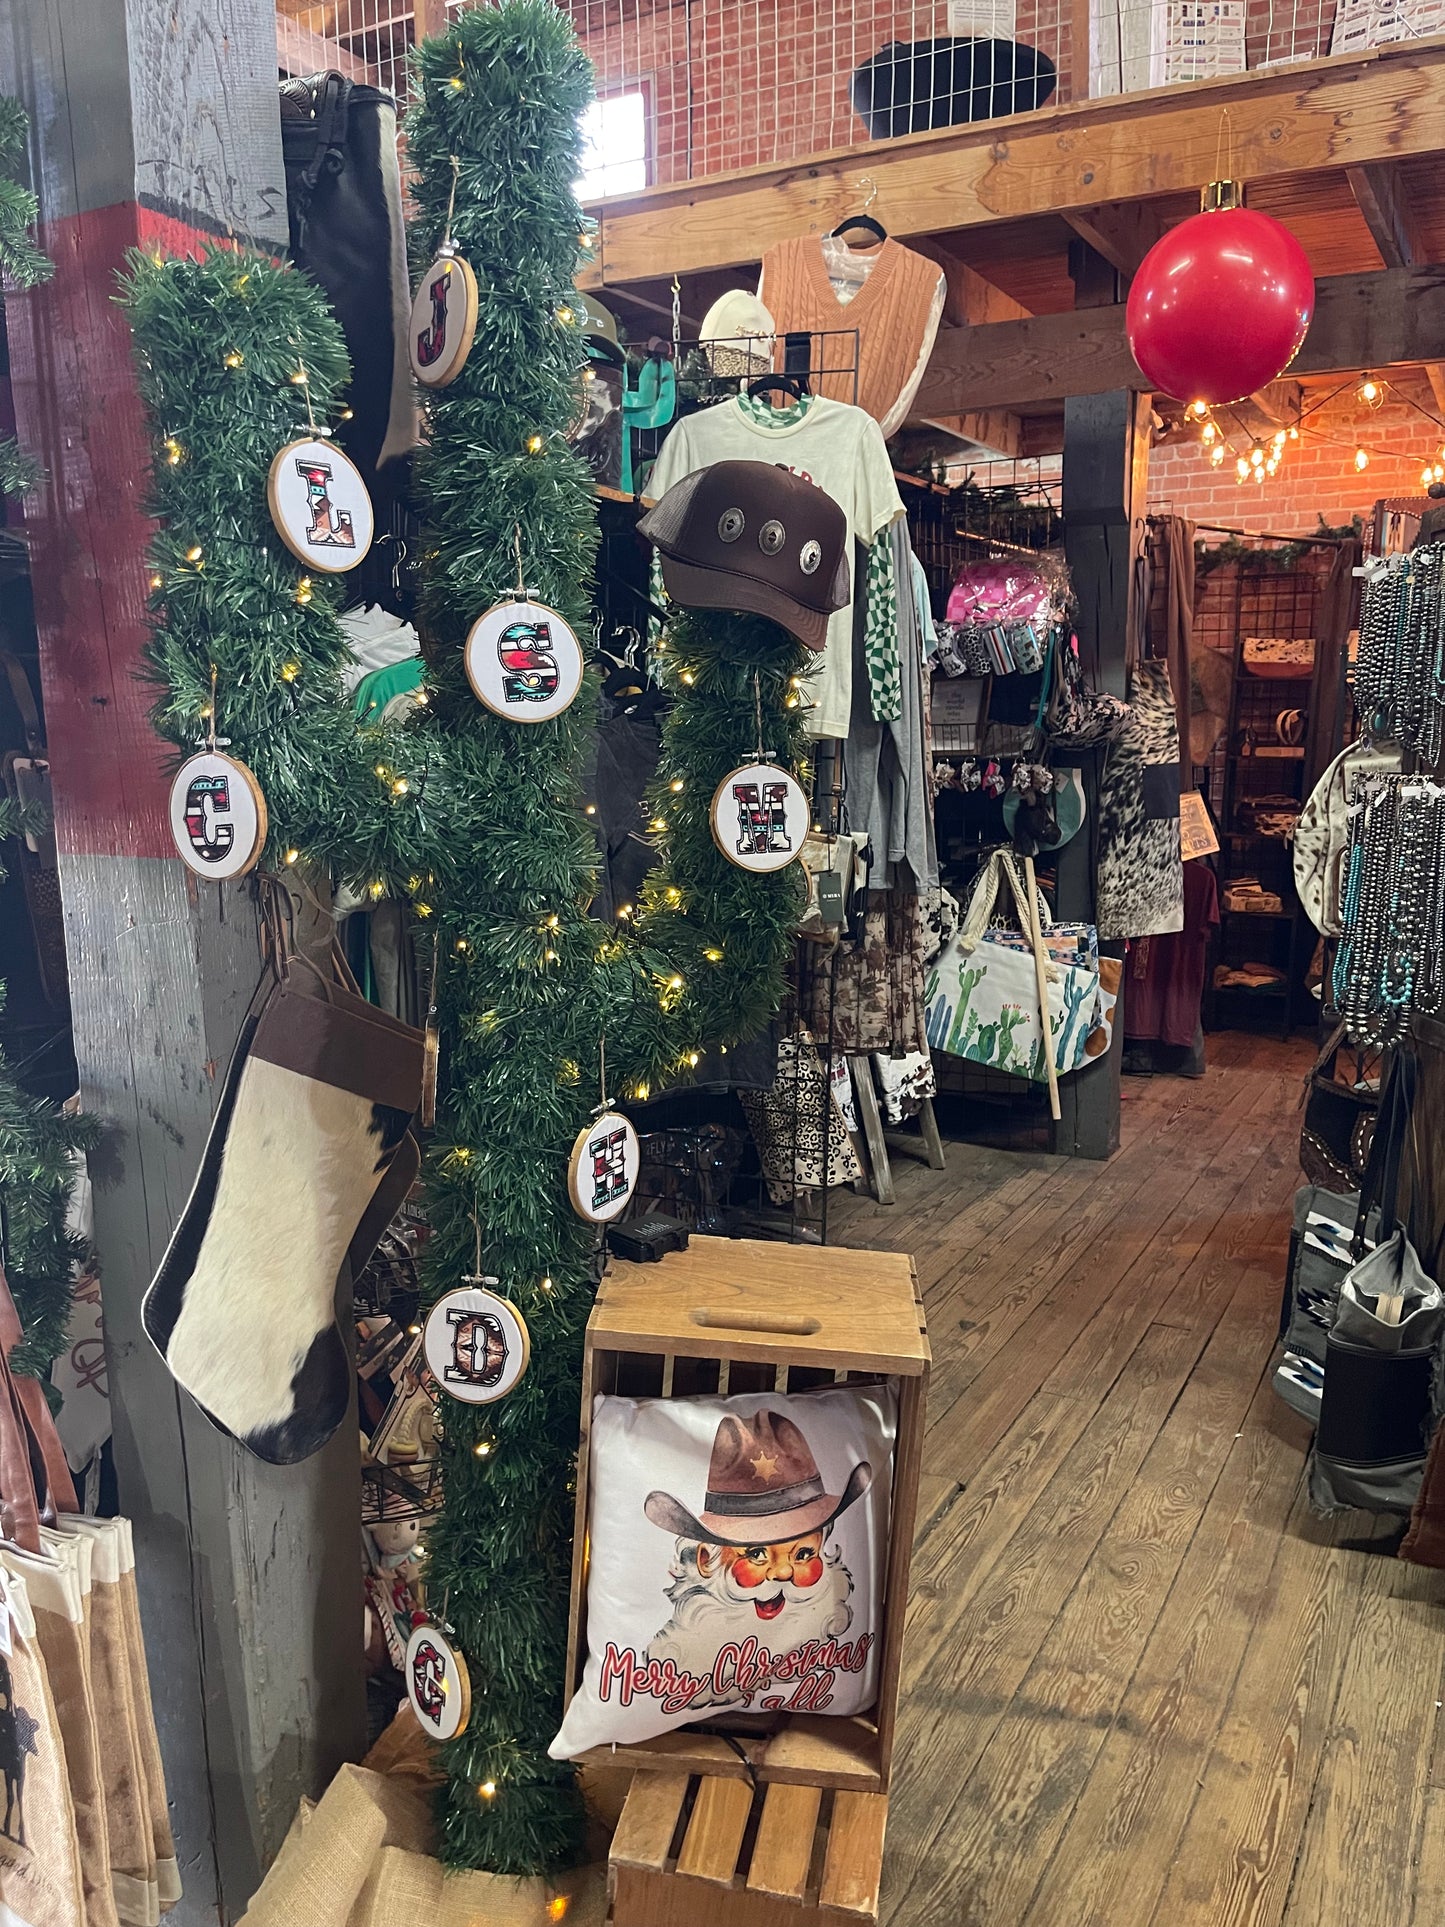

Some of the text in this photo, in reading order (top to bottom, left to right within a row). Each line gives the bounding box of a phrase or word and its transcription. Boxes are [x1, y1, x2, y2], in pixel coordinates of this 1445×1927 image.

[417, 271, 451, 367] J
[295, 459, 357, 548] L
[497, 621, 560, 703] S
[183, 775, 234, 862] C
[733, 782, 792, 855] M
[589, 1126, 629, 1212] H
[444, 1308, 510, 1387] D
[600, 1641, 711, 1713] Merry
